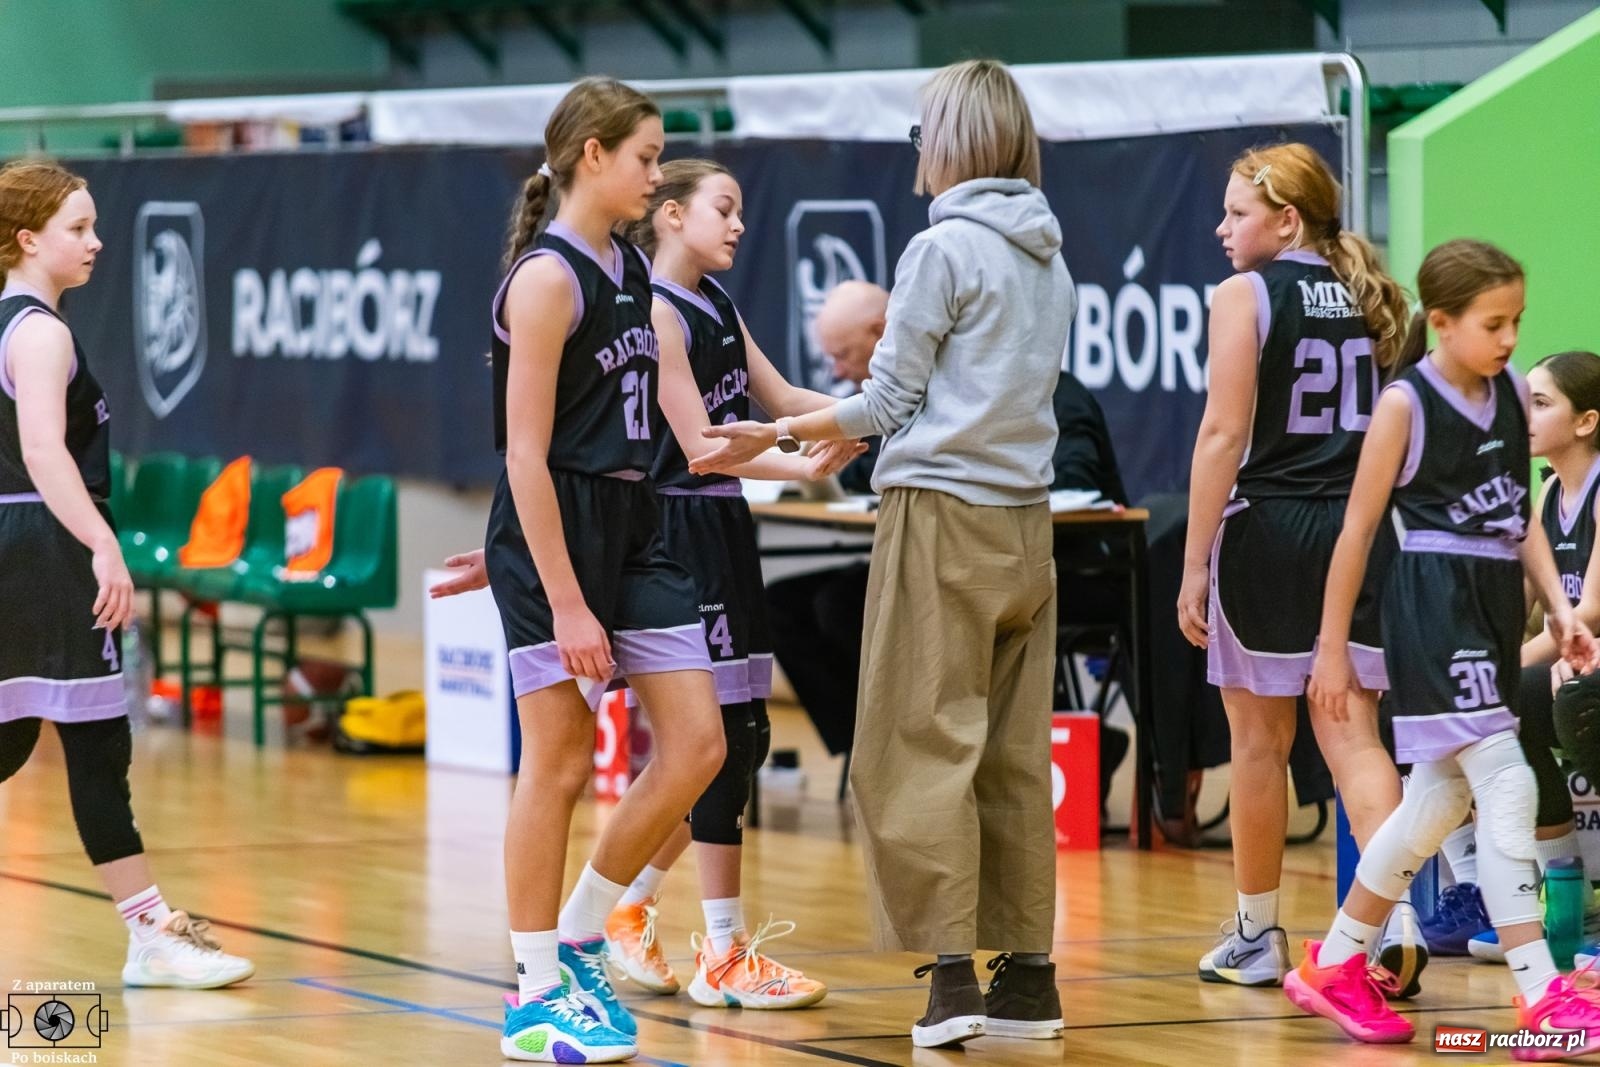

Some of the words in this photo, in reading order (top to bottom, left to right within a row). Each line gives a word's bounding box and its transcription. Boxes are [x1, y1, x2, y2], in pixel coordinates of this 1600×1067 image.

[1061, 244, 1215, 393] BÓR
[621, 370, 650, 440] 21
[1286, 338, 1379, 434] 20
[102, 626, 119, 672] 4
[1448, 661, 1501, 710] 30
